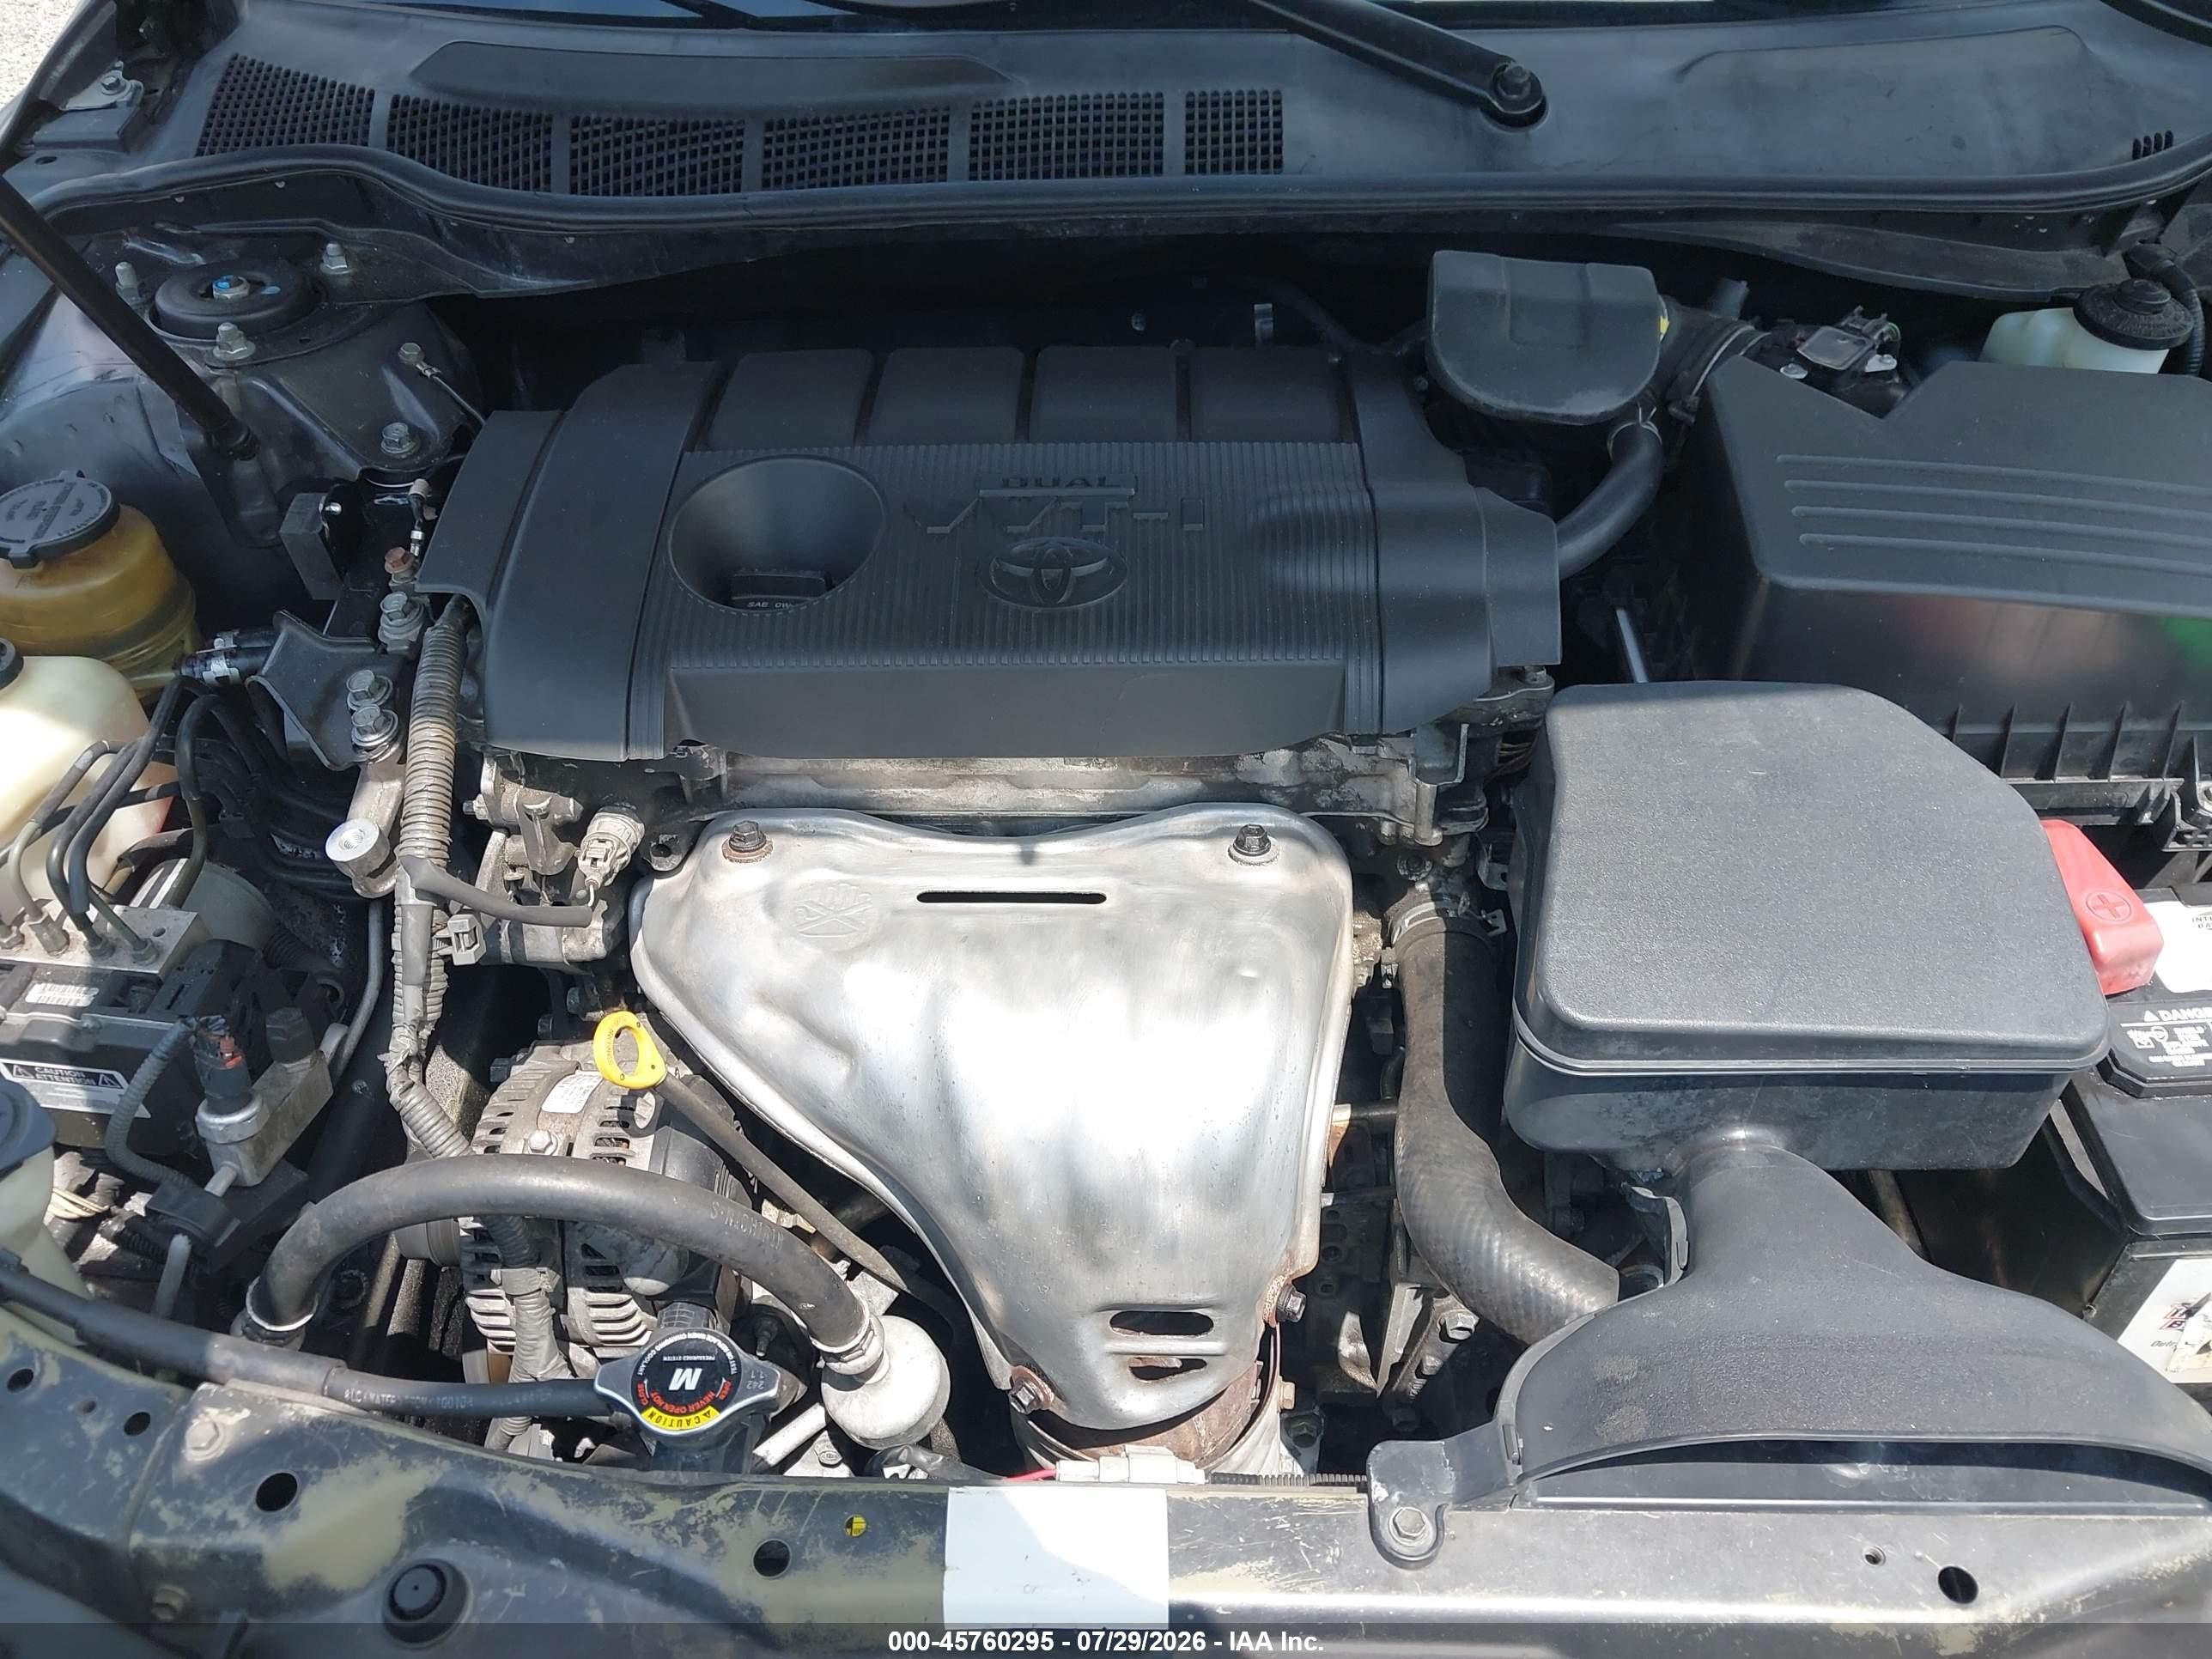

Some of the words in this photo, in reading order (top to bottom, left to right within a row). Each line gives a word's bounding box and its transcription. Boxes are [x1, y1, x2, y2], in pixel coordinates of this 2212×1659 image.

[34, 1066, 86, 1079] CAUTION
[34, 1073, 97, 1086] ATTENTION
[637, 1349, 656, 1376] COOLANT
[668, 1368, 702, 1390] M
[746, 1380, 764, 1389] 242
[650, 1390, 665, 1408] HOT
[664, 1401, 687, 1414] OPEN
[688, 1390, 715, 1413] NEVER
[647, 1411, 701, 1428] CAUTION
